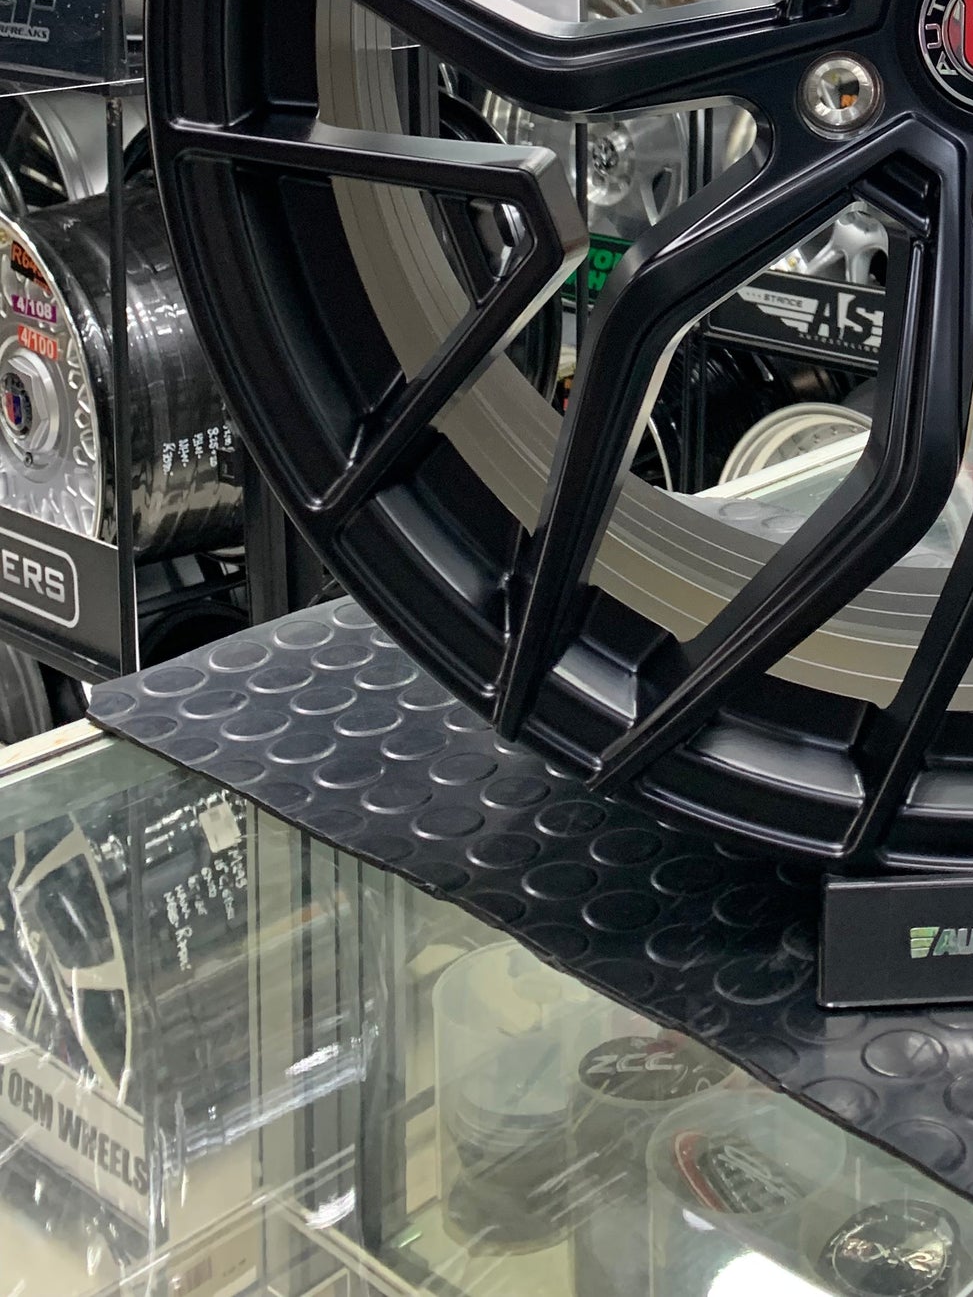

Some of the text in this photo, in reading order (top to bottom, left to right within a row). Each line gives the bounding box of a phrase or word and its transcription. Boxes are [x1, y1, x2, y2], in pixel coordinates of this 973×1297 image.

[16, 296, 53, 321] 4/108
[20, 327, 55, 360] 4/100
[8, 1068, 149, 1196] OEM WHEELS
